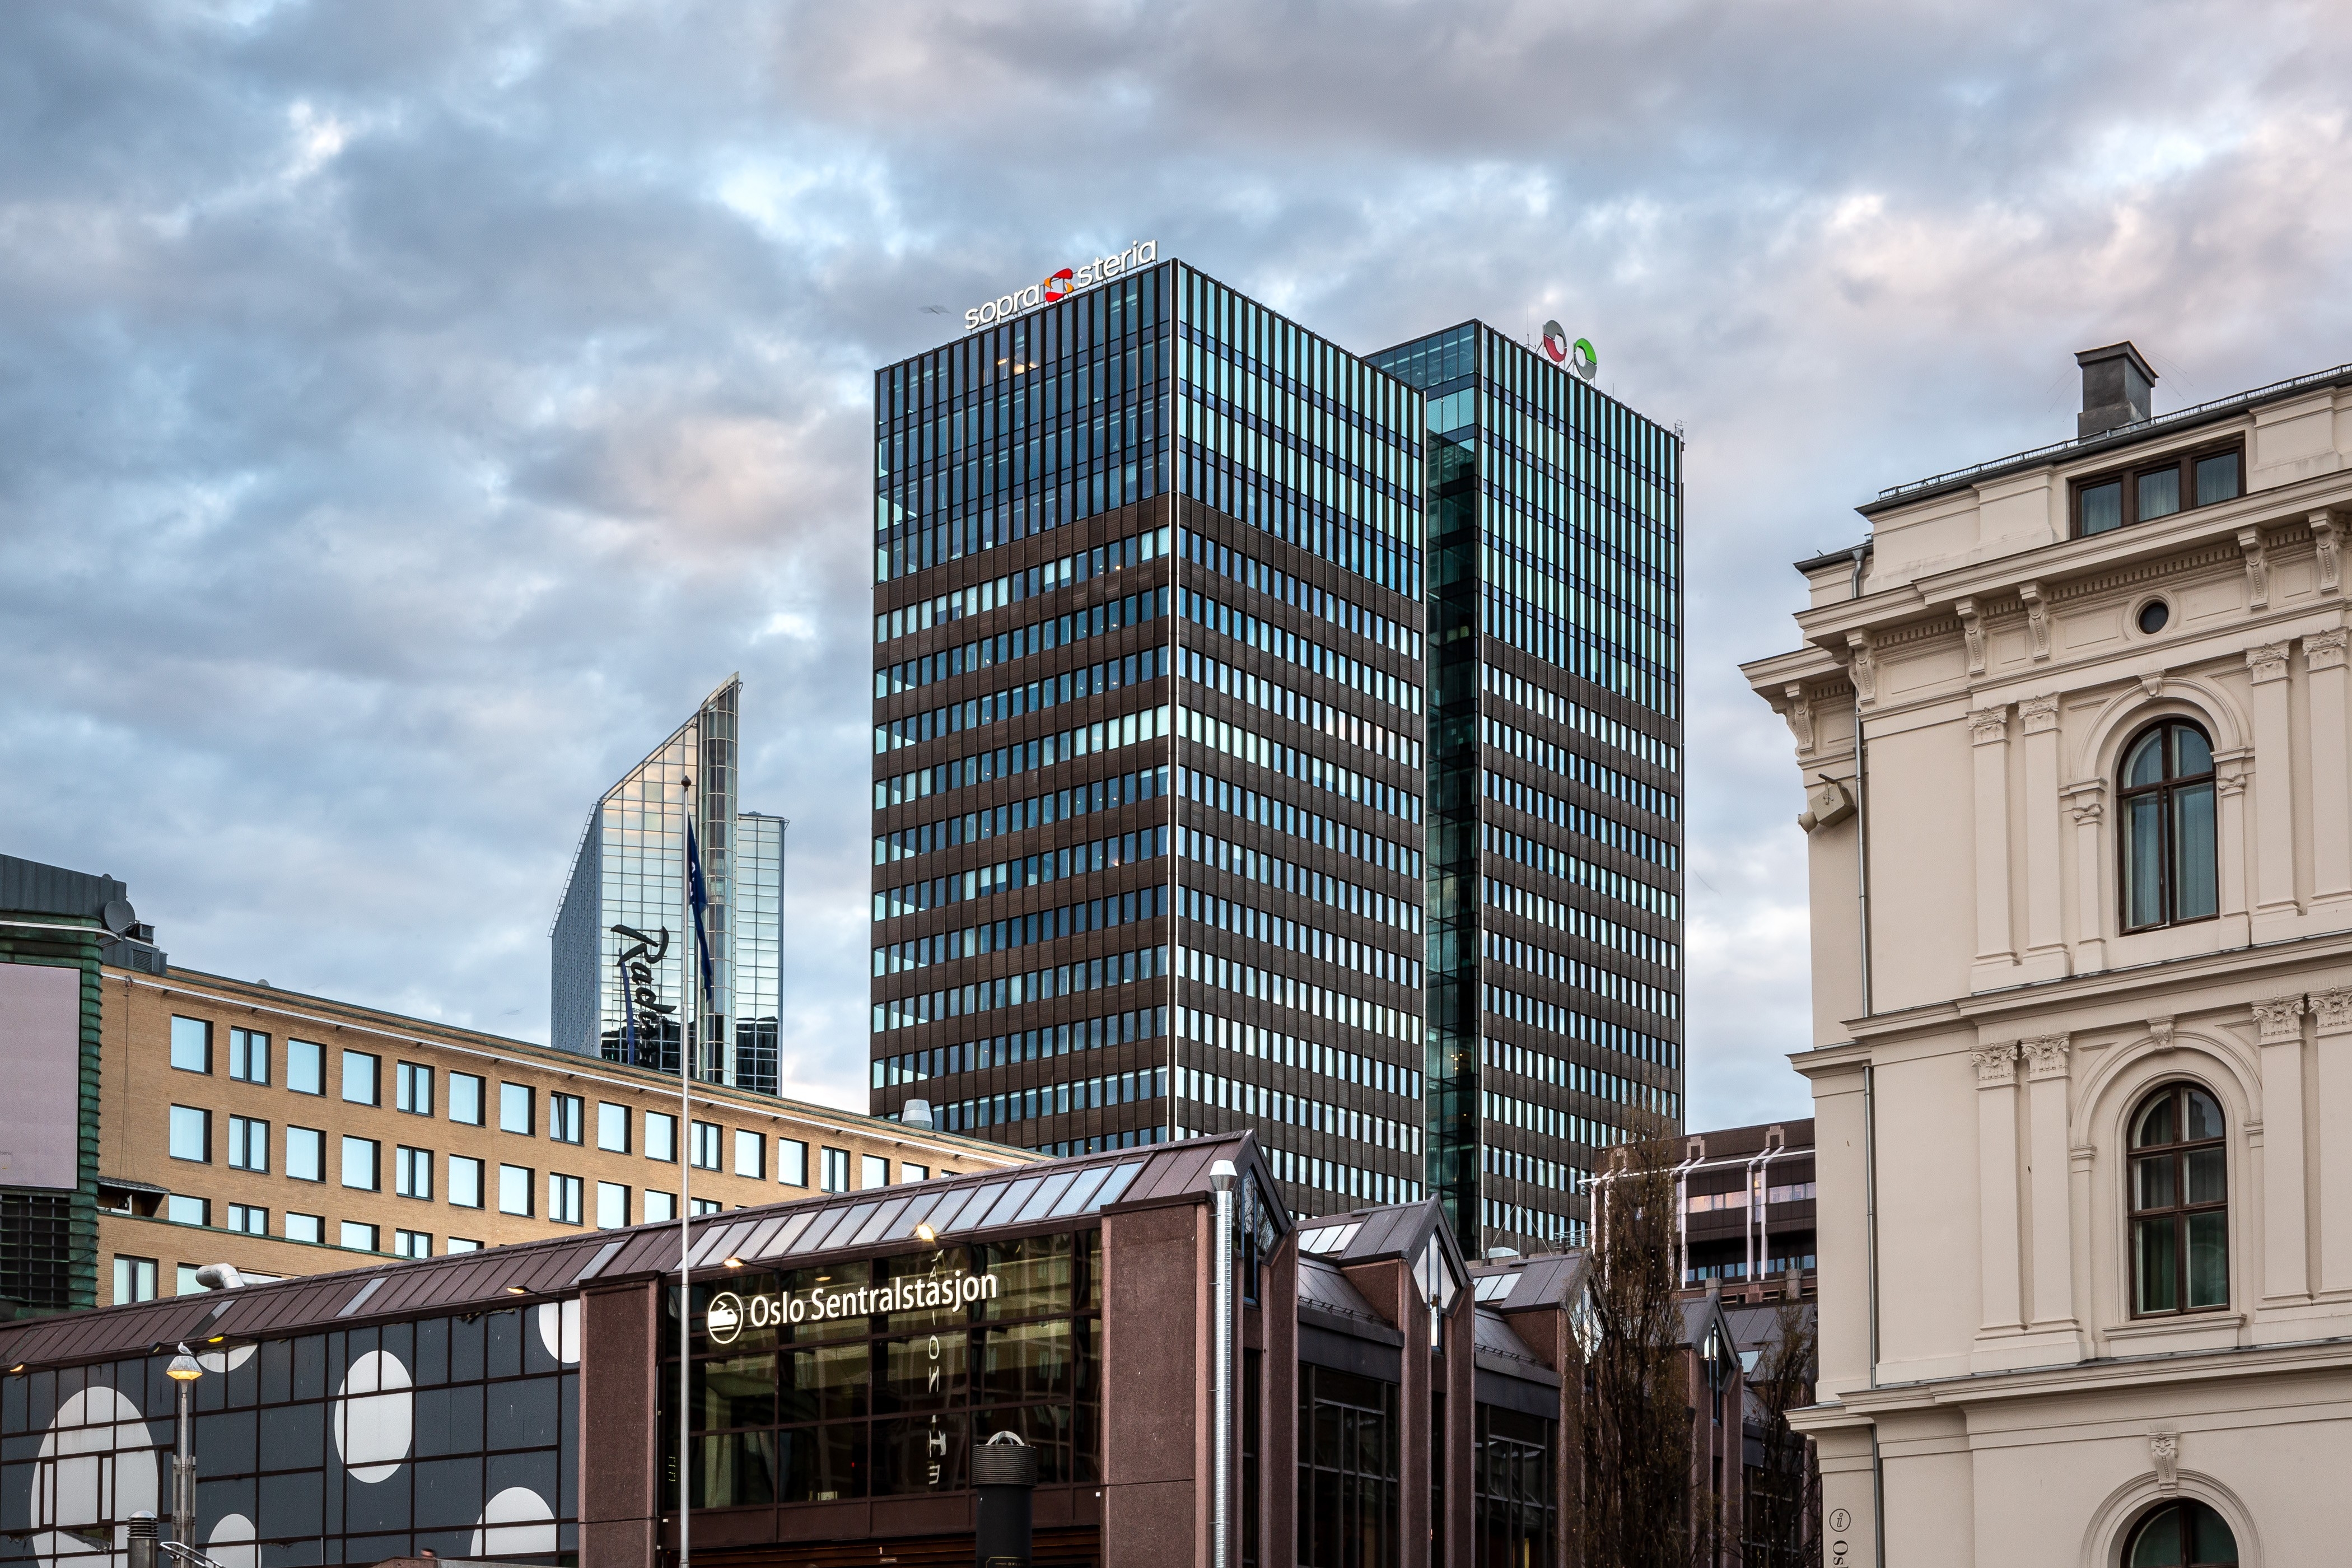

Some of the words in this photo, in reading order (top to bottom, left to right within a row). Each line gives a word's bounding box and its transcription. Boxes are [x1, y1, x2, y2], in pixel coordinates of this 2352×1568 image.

[964, 283, 1040, 330] sopra
[1077, 239, 1158, 288] steria
[749, 1290, 805, 1328] Oslo
[810, 1270, 998, 1321] Sentralstasjon
[879, 1546, 883, 1555] 1
